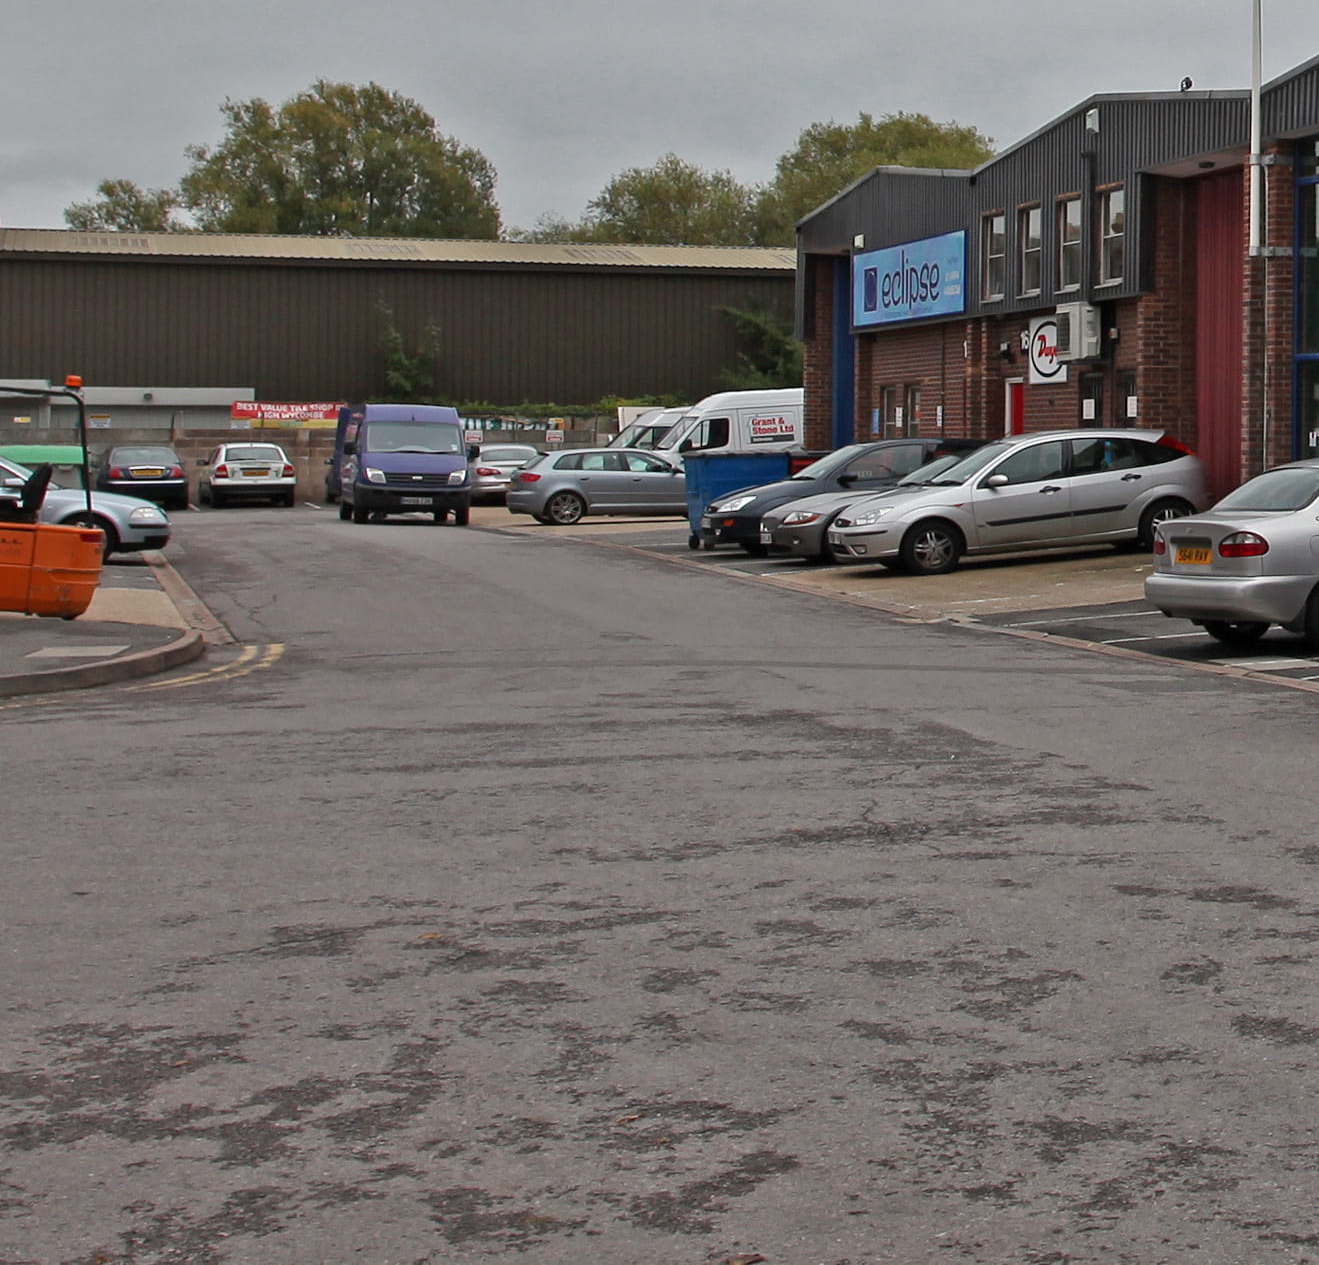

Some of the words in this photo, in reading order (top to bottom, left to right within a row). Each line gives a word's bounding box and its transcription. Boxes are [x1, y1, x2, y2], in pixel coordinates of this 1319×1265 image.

[882, 249, 940, 310] eclipse
[260, 403, 288, 412] VALUE
[752, 417, 776, 426] Grant
[752, 426, 778, 435] Stone
[780, 425, 794, 433] Ltd
